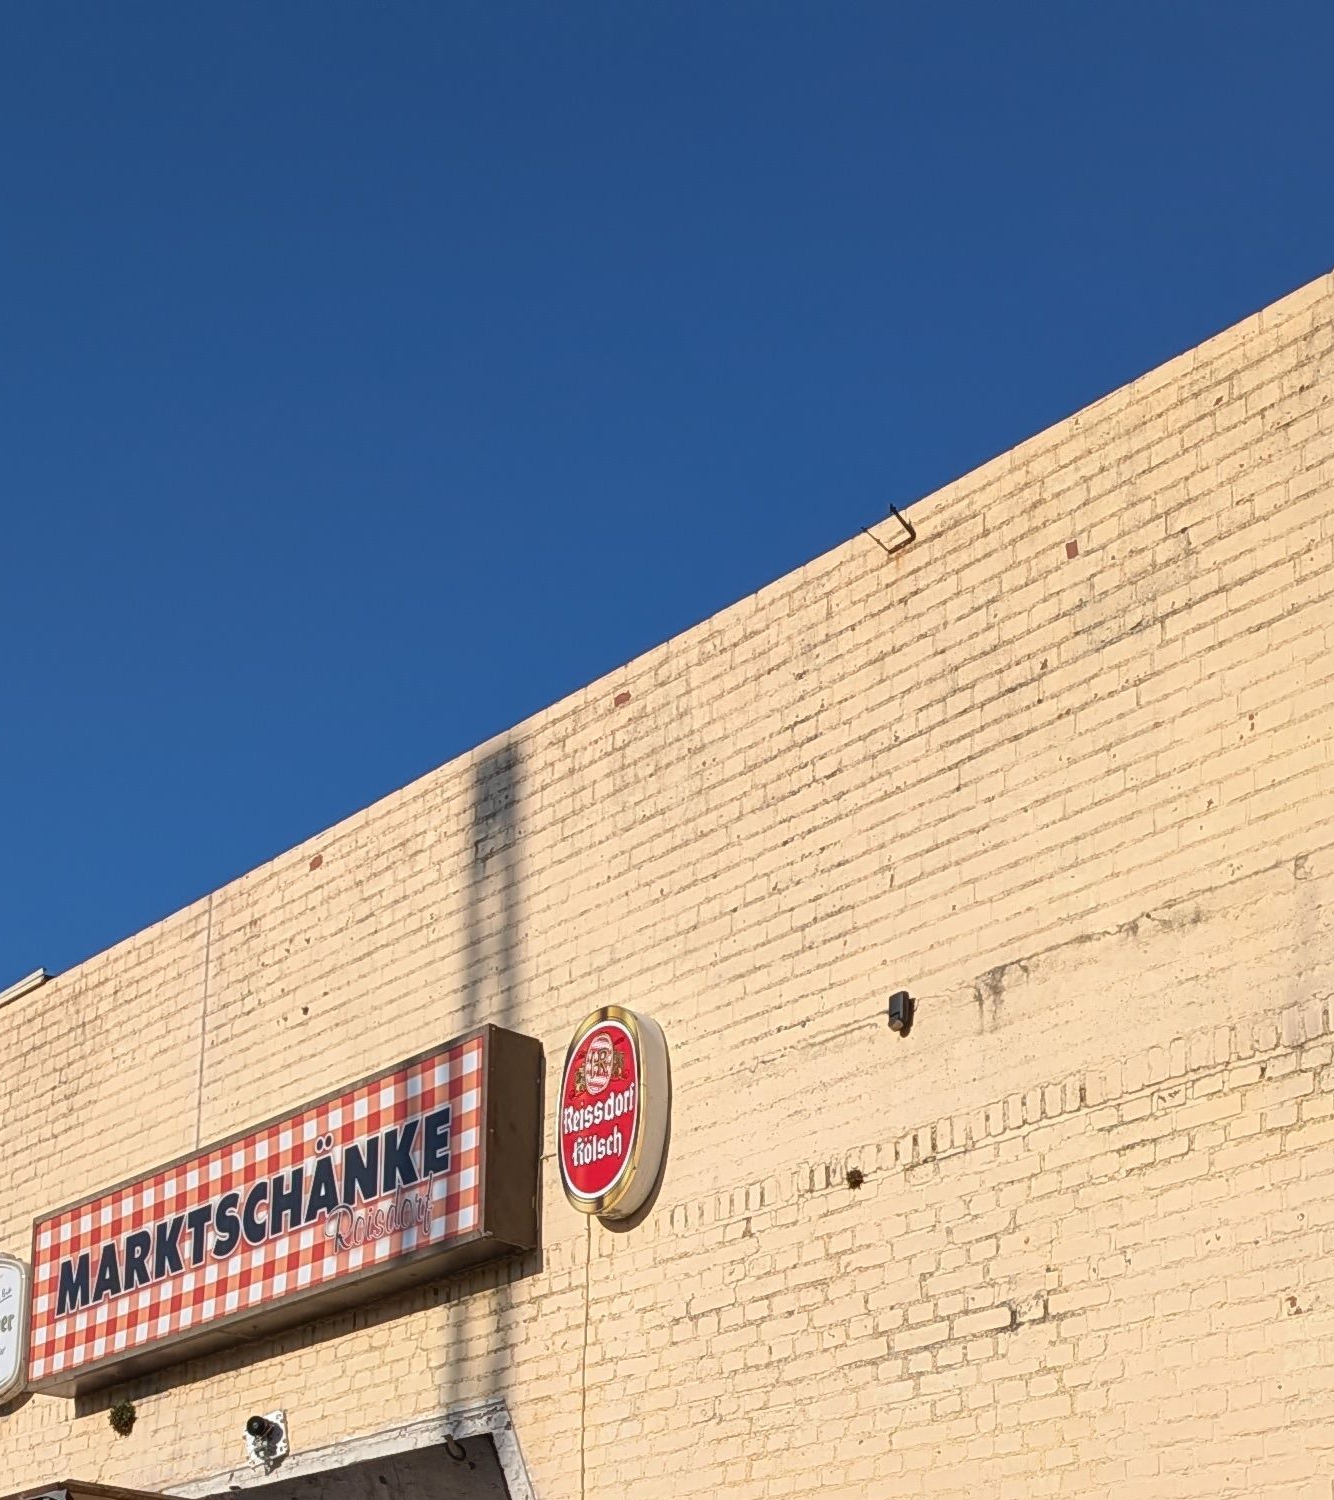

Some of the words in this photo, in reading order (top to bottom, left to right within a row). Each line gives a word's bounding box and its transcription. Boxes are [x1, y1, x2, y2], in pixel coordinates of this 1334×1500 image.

[563, 1082, 635, 1134] Reissdorf
[573, 1125, 622, 1167] Kölsch
[55, 1105, 451, 1316] MARKTSCHÄNKE
[324, 1171, 435, 1254] Roisdorf
